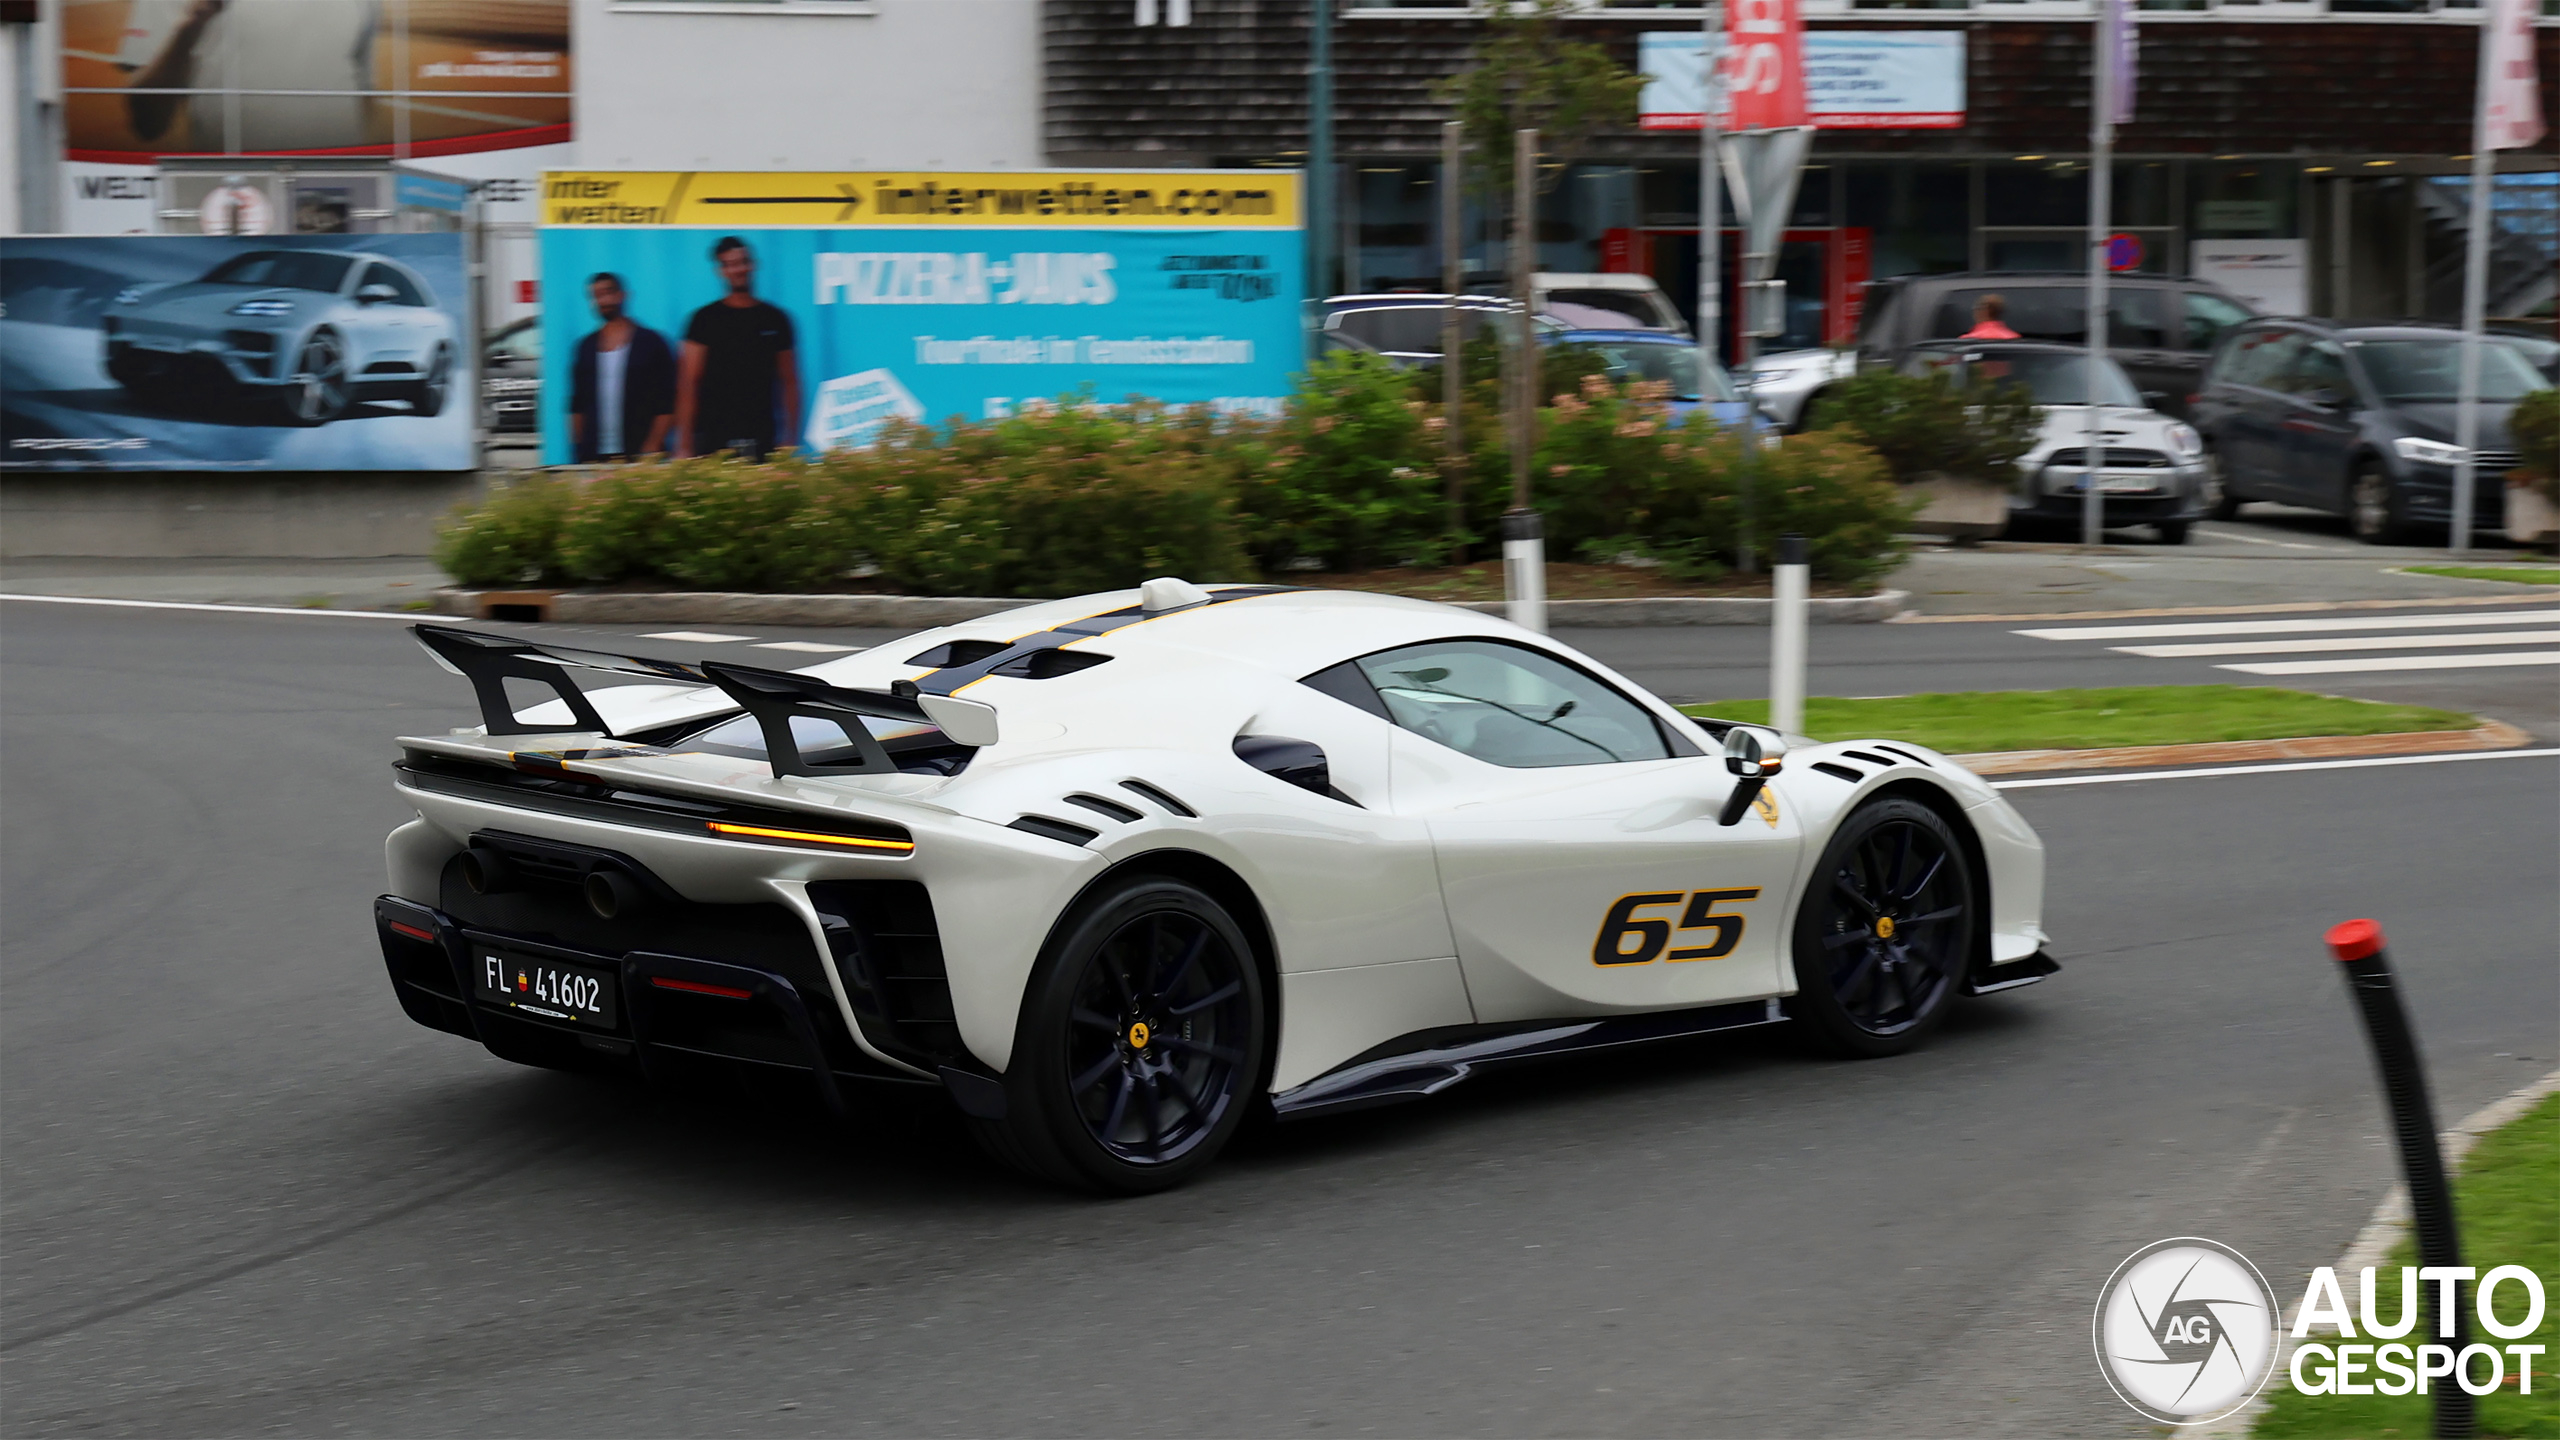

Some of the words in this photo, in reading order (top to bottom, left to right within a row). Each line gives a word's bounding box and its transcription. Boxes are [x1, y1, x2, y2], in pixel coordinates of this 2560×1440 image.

[873, 178, 1277, 216] interwetten.com
[1591, 885, 1763, 968] 65
[485, 955, 512, 993] FL
[535, 967, 601, 1013] 41602
